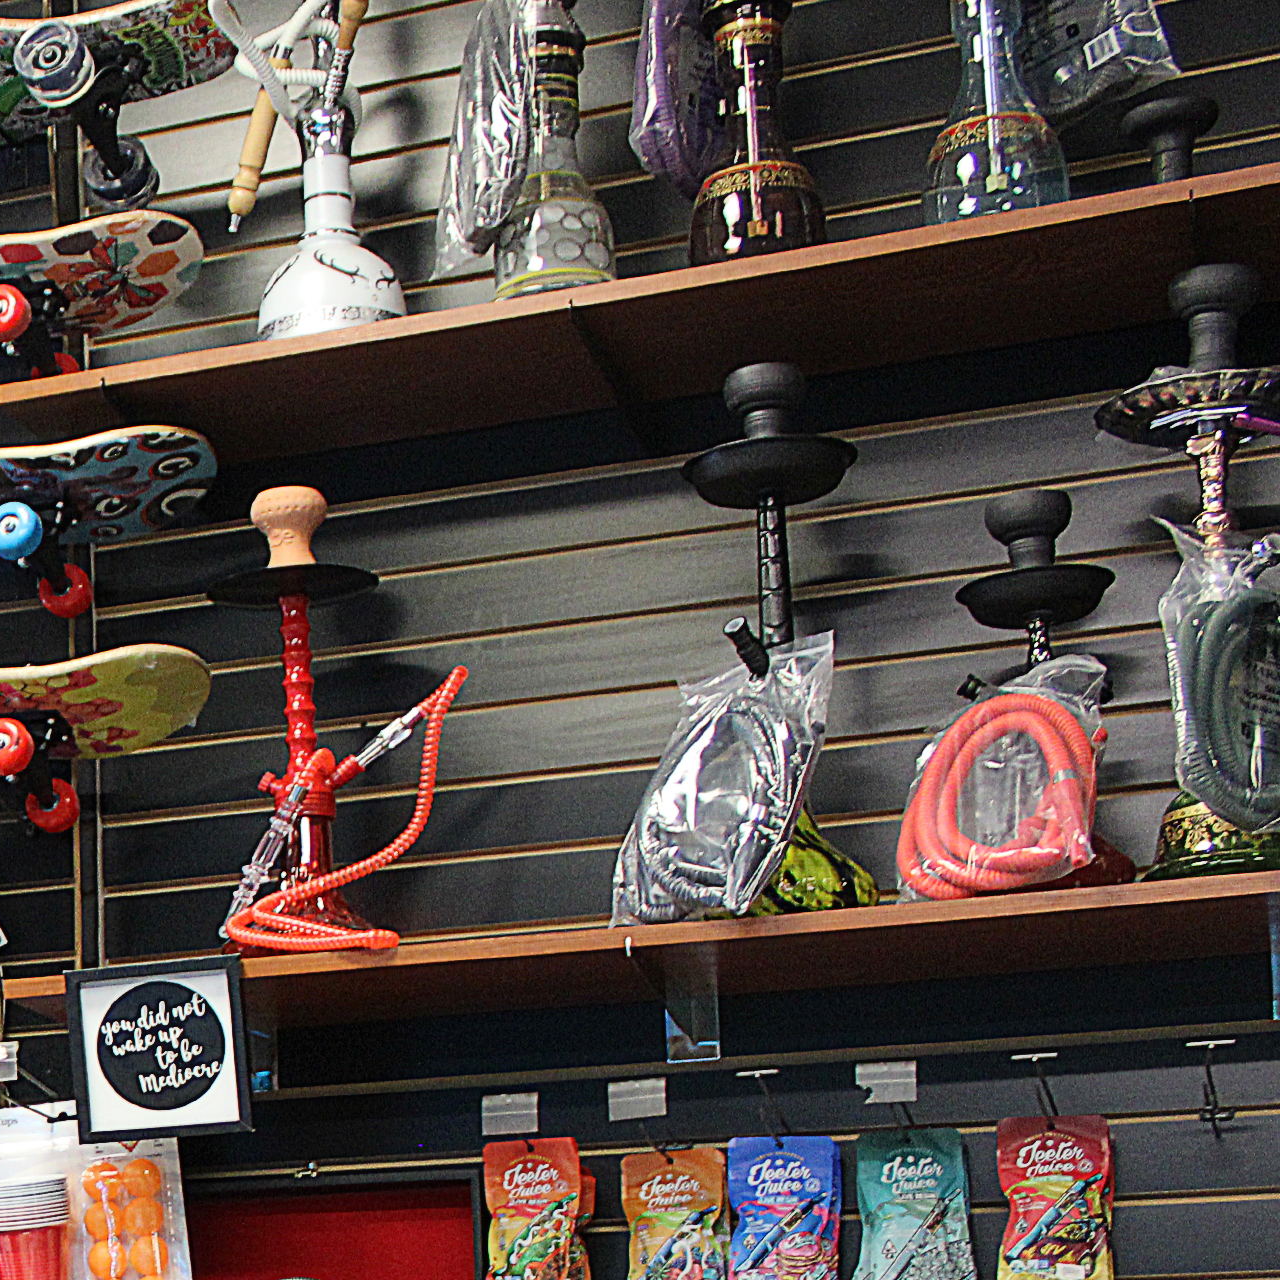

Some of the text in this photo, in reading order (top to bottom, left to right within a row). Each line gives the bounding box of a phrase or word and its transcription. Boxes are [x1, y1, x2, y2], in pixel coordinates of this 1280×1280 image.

[101, 993, 206, 1046] you did not
[112, 1026, 184, 1056] wake up
[155, 1039, 203, 1070] to be
[139, 1060, 221, 1093] Mediocre
[1016, 1139, 1085, 1170] Jeeter
[503, 1162, 559, 1190] Jeeter
[748, 1157, 811, 1186] Jeeter
[881, 1155, 944, 1182] Jeeter
[1026, 1162, 1075, 1178] Juice
[509, 1183, 552, 1199] Juice
[640, 1175, 700, 1200] Jeeter
[755, 1179, 803, 1198] Juice
[892, 1178, 938, 1194] Juice
[647, 1193, 693, 1208] Juice
